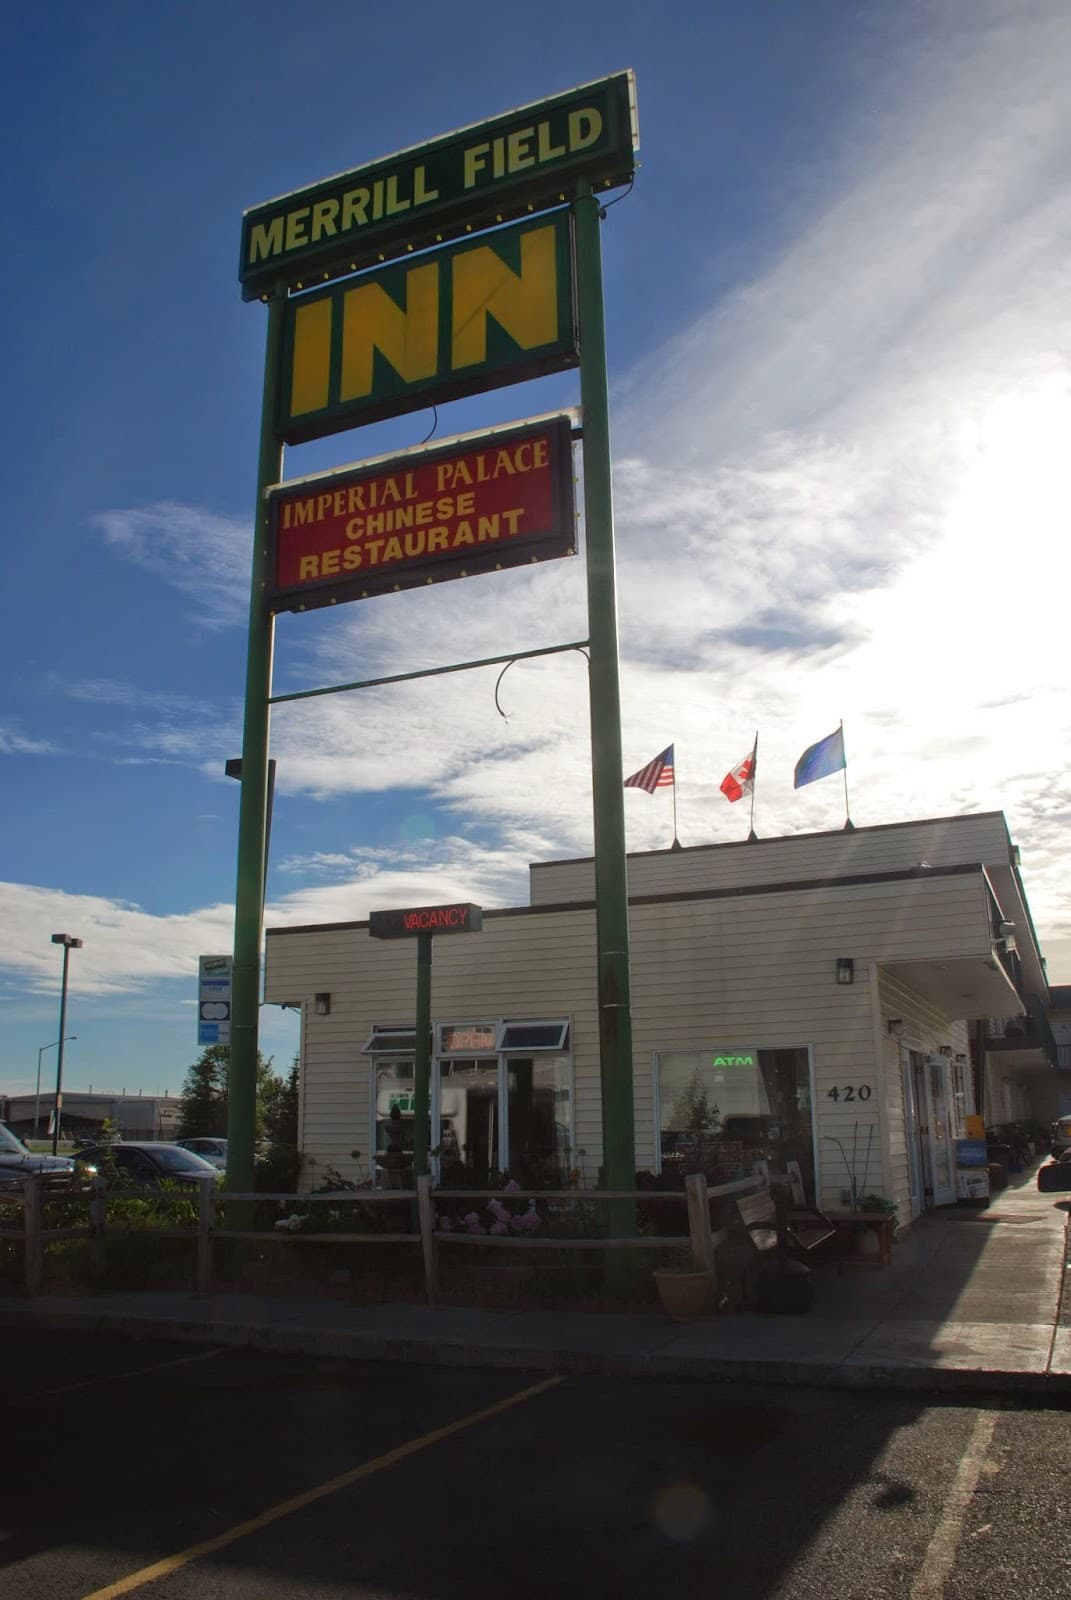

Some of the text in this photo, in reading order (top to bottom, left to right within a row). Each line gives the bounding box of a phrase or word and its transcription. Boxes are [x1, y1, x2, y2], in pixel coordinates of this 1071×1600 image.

[249, 107, 603, 264] MERRILL FIELD
[290, 225, 559, 418] INN
[282, 439, 549, 530] IMPERIAL PALACE
[346, 492, 476, 540] CHINESE
[299, 508, 525, 580] RESTAURANT
[403, 908, 467, 930] VACANCY
[447, 1030, 492, 1050] OPEN
[713, 1055, 753, 1067] ATM
[828, 1084, 872, 1102] 420
